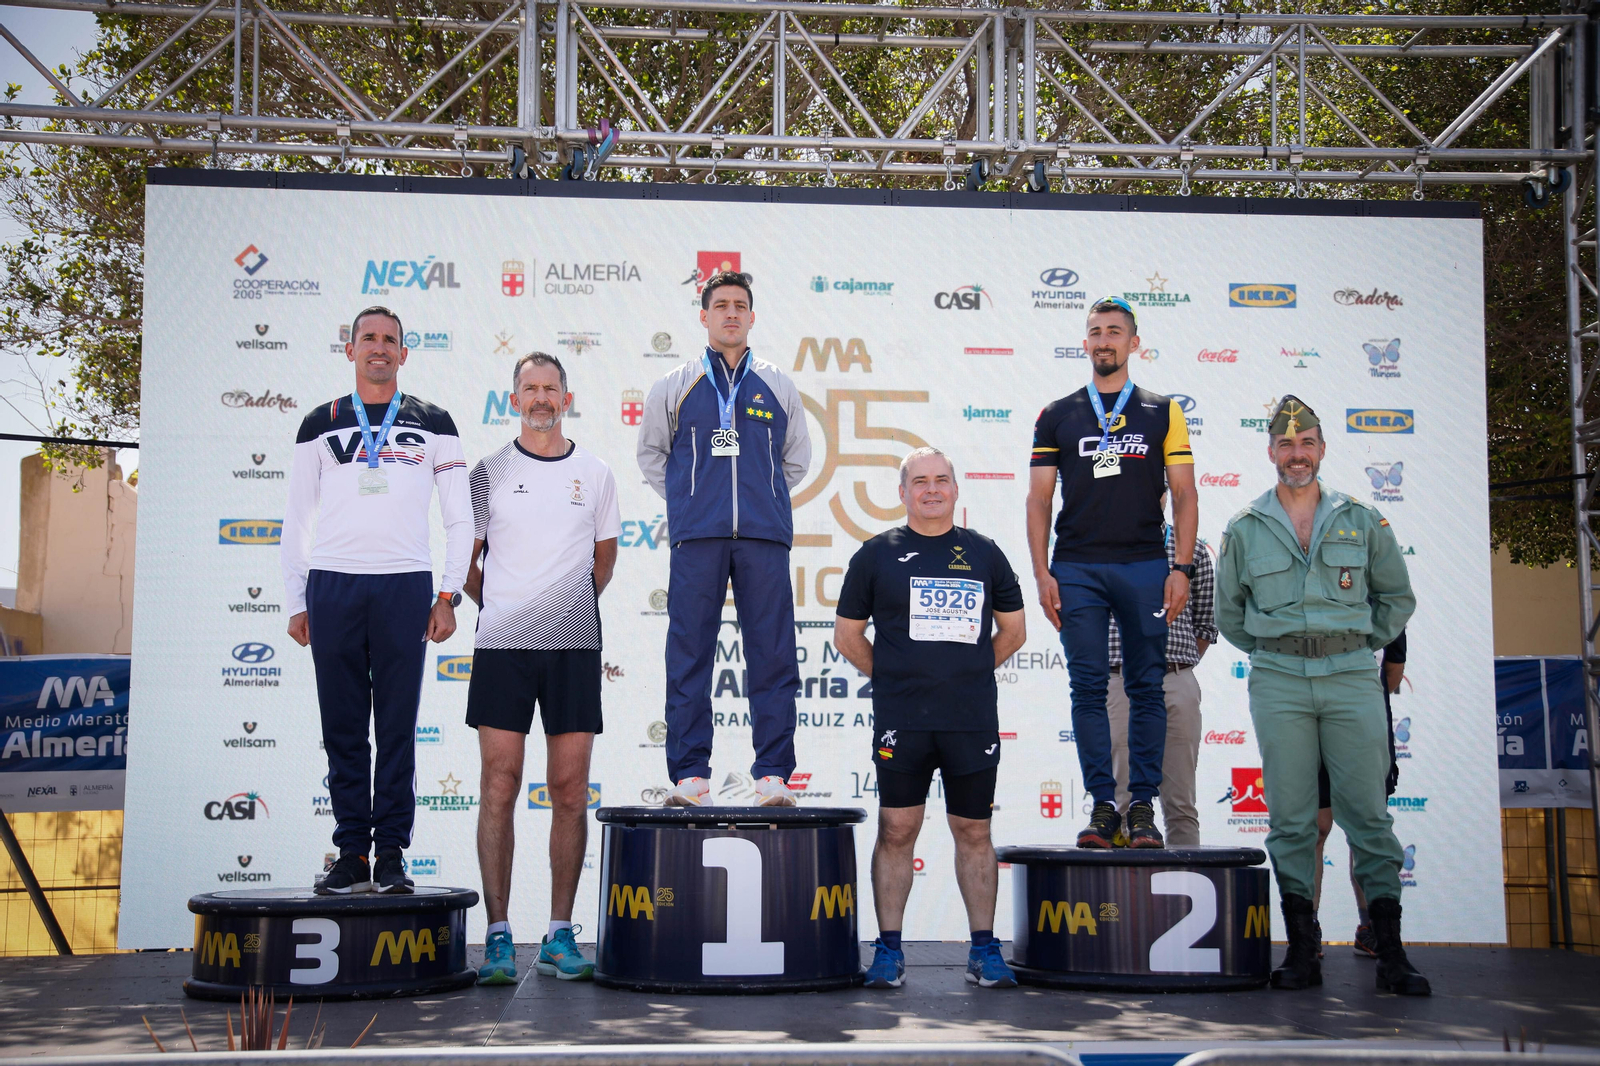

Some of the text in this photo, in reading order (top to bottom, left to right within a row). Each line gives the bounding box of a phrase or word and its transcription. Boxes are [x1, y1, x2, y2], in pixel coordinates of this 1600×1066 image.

[361, 255, 460, 294] NEXAL
[545, 262, 641, 281] ALMERÍA
[233, 279, 319, 290] COOPERACIÓN
[545, 284, 594, 295] CIUDAD
[833, 278, 894, 294] cajamar
[233, 290, 262, 299] 2005
[1031, 291, 1086, 299] HYUNDAI
[1123, 292, 1191, 302] ESTRELLA
[1239, 291, 1290, 300] IKEA
[934, 291, 980, 310] CASI
[1034, 301, 1085, 309] Almerialva
[236, 339, 288, 350] vellsam
[1356, 416, 1406, 426] IKEA
[232, 469, 284, 479] vellsam
[919, 589, 976, 610] 5926
[228, 602, 280, 612] vellsam
[222, 667, 281, 676] HYUNDAI
[224, 677, 279, 687] Almerialva
[6, 712, 129, 729] Medio Marató
[223, 738, 276, 748] vellsam
[27, 785, 58, 797] NEXAL
[83, 783, 114, 791] ALMERÍA
[416, 796, 480, 805] ESTRELL
[204, 801, 256, 820] CASI
[218, 871, 271, 882] vellsam
[657, 887, 674, 901] 25
[702, 837, 784, 975] 1
[1100, 902, 1119, 916] 25
[1150, 871, 1221, 972] 2
[437, 926, 450, 940] 25
[244, 934, 261, 948] 25
[290, 918, 340, 985] 3
